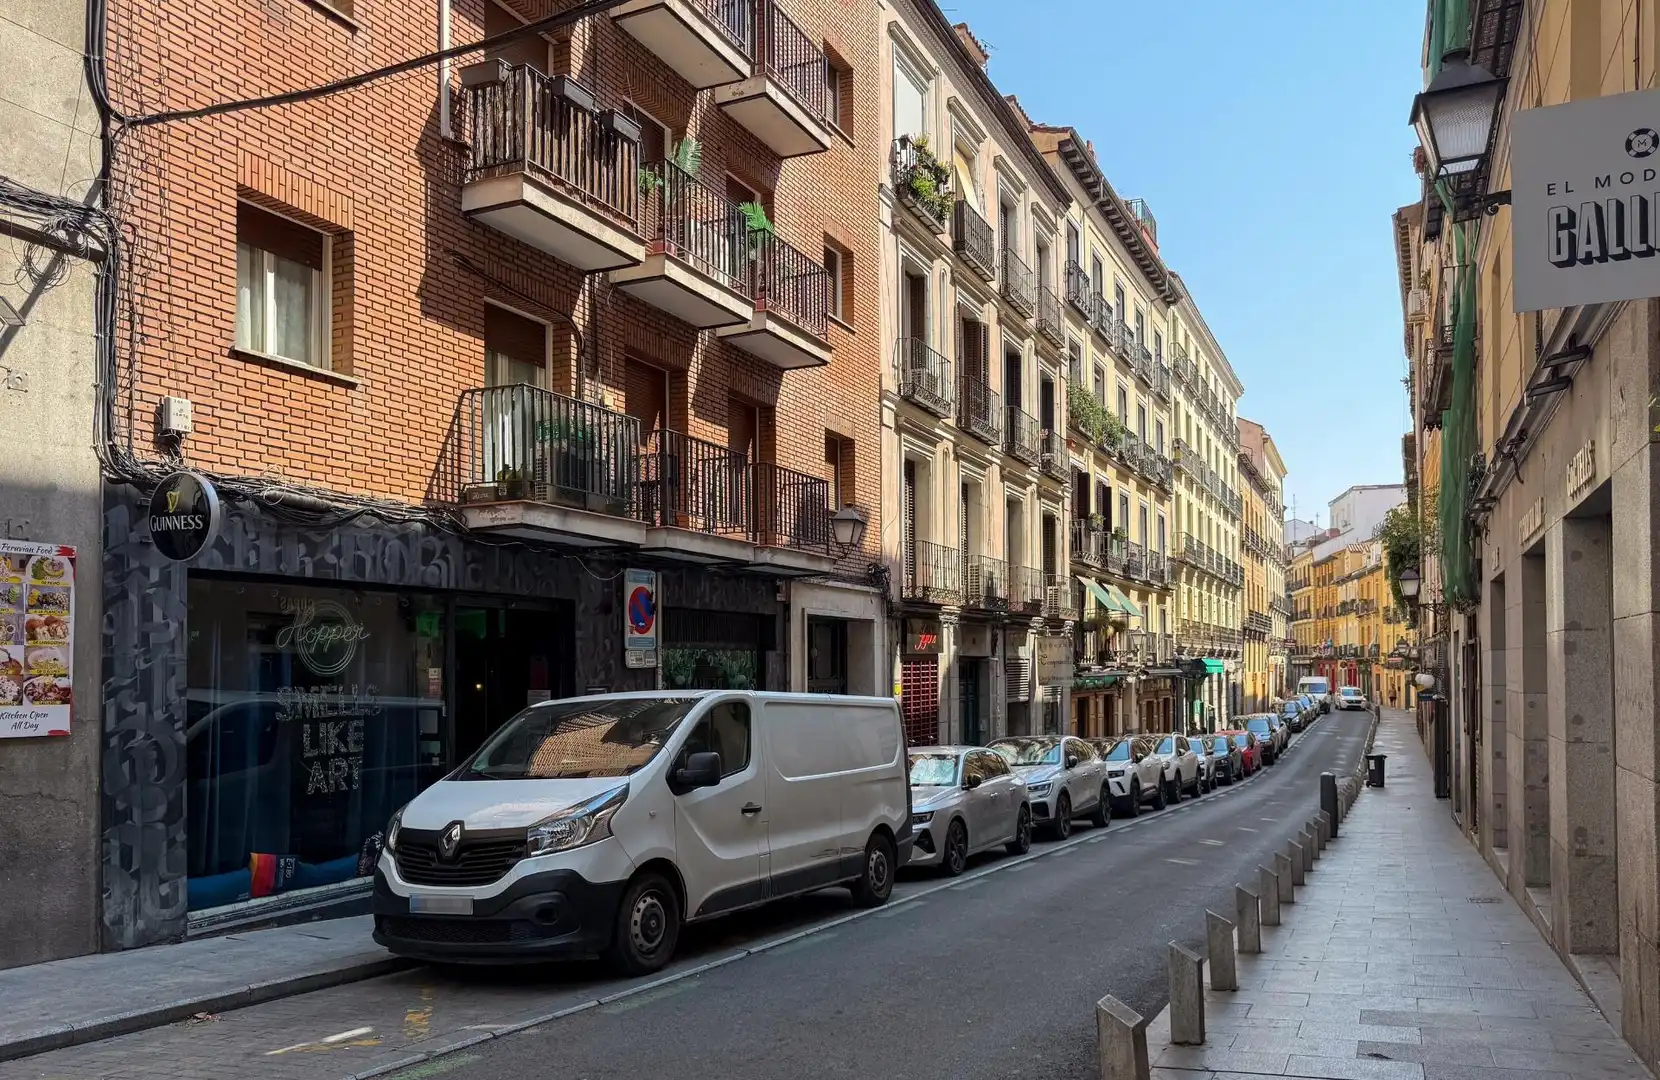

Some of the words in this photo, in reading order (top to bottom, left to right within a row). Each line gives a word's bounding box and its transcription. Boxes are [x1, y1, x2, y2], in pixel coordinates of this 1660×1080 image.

[1547, 181, 1574, 196] EL
[150, 514, 203, 532] GUINNESS
[1, 542, 34, 554] Peruvian
[35, 545, 53, 555] Food
[276, 607, 371, 653] Hopper
[275, 684, 381, 721] SMELLS
[0, 710, 28, 720] Kitchen
[29, 710, 49, 721] Open
[11, 720, 23, 730] All
[24, 721, 39, 732] Day
[303, 719, 364, 758] LIKE
[306, 756, 363, 795] ART
